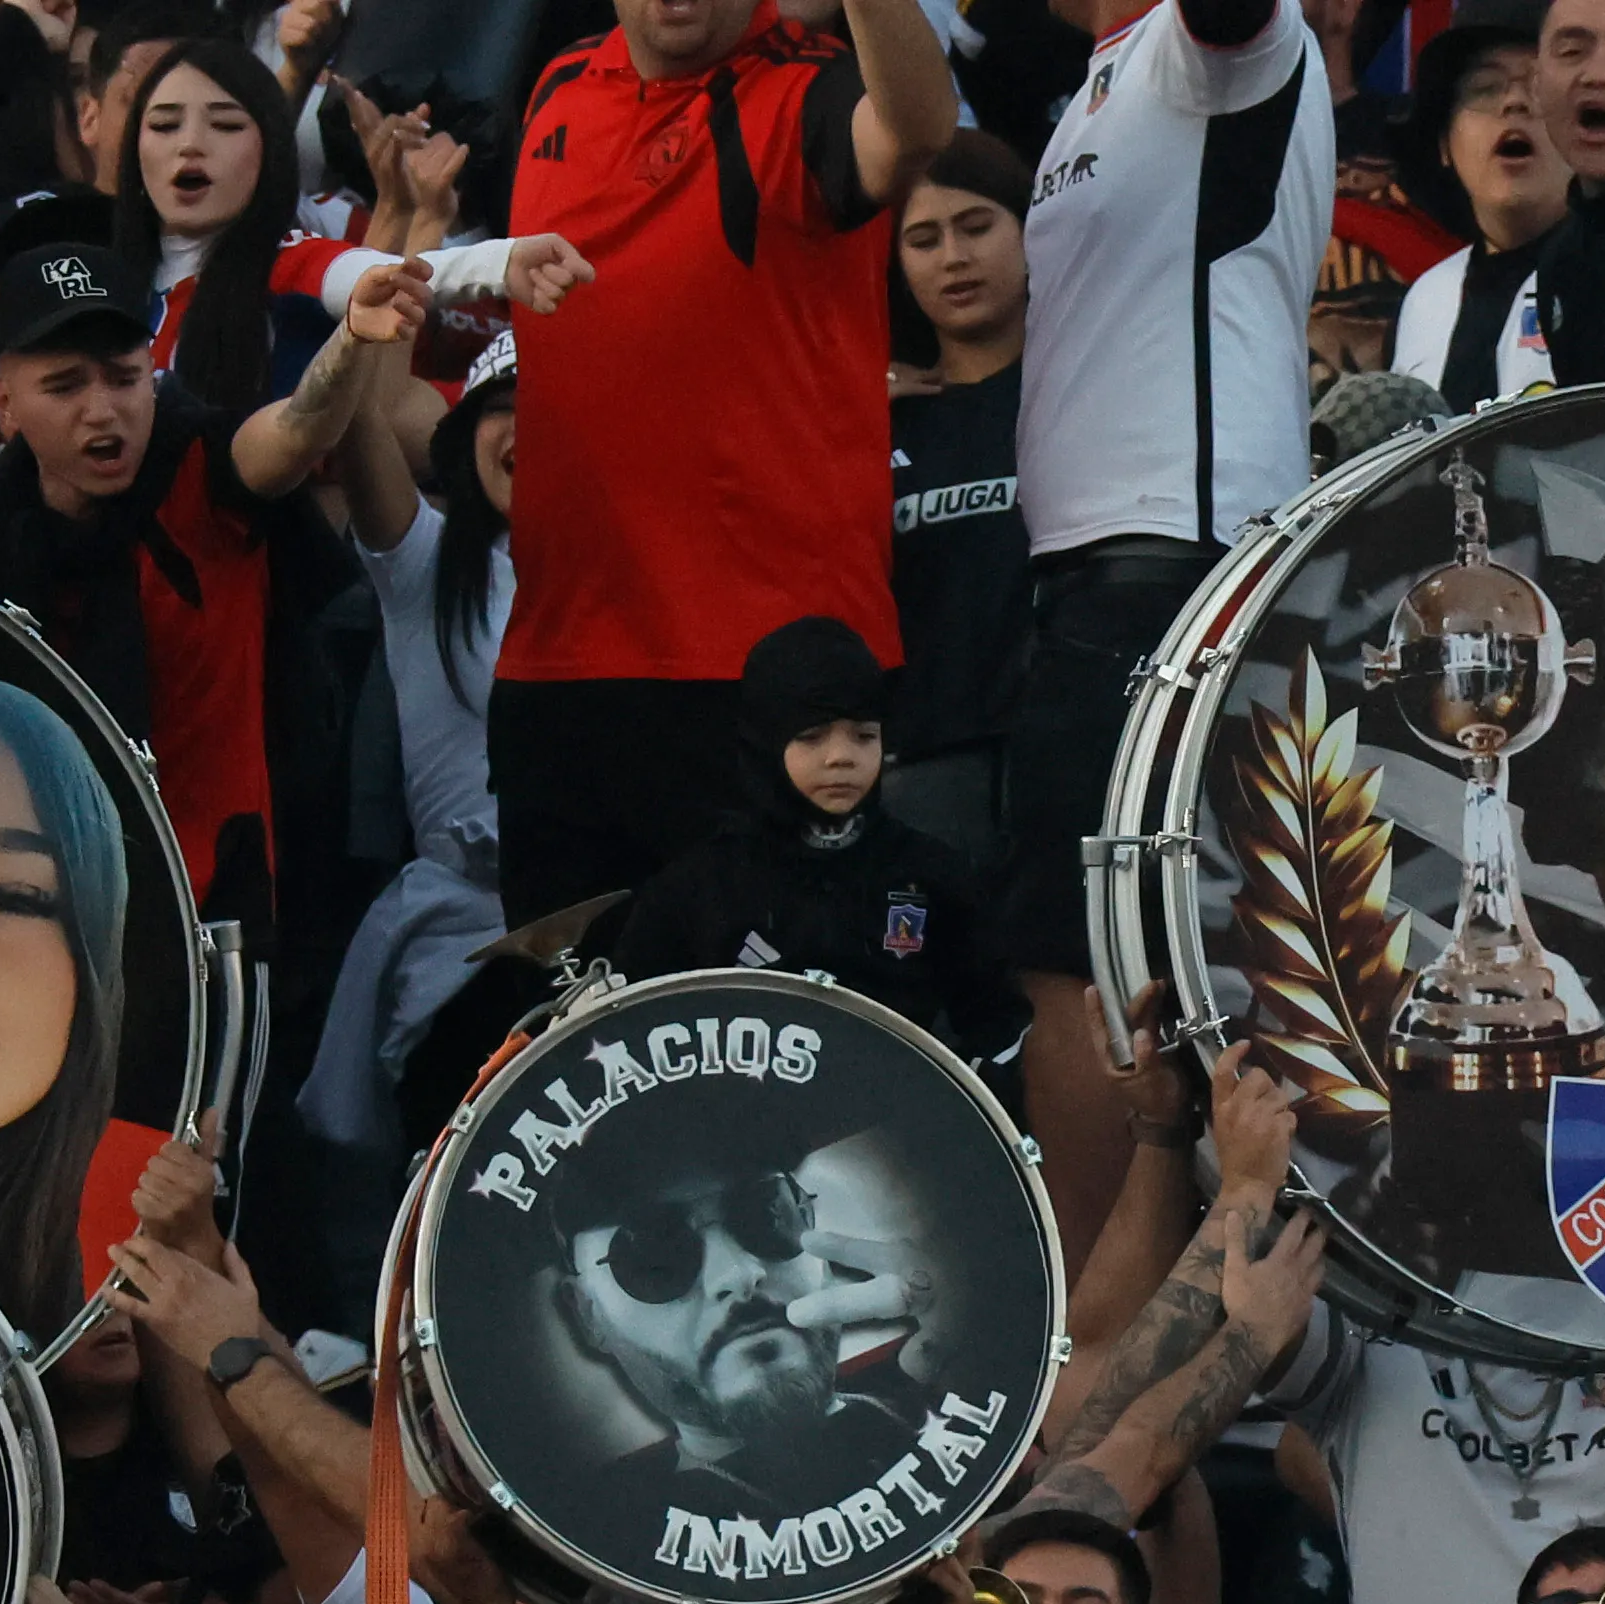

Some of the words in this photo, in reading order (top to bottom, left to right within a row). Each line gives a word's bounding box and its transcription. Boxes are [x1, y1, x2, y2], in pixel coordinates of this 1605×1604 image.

[925, 482, 1008, 519] JUGA
[479, 1017, 823, 1212] PALACIOS
[655, 1388, 1006, 1580] INMORTAL
